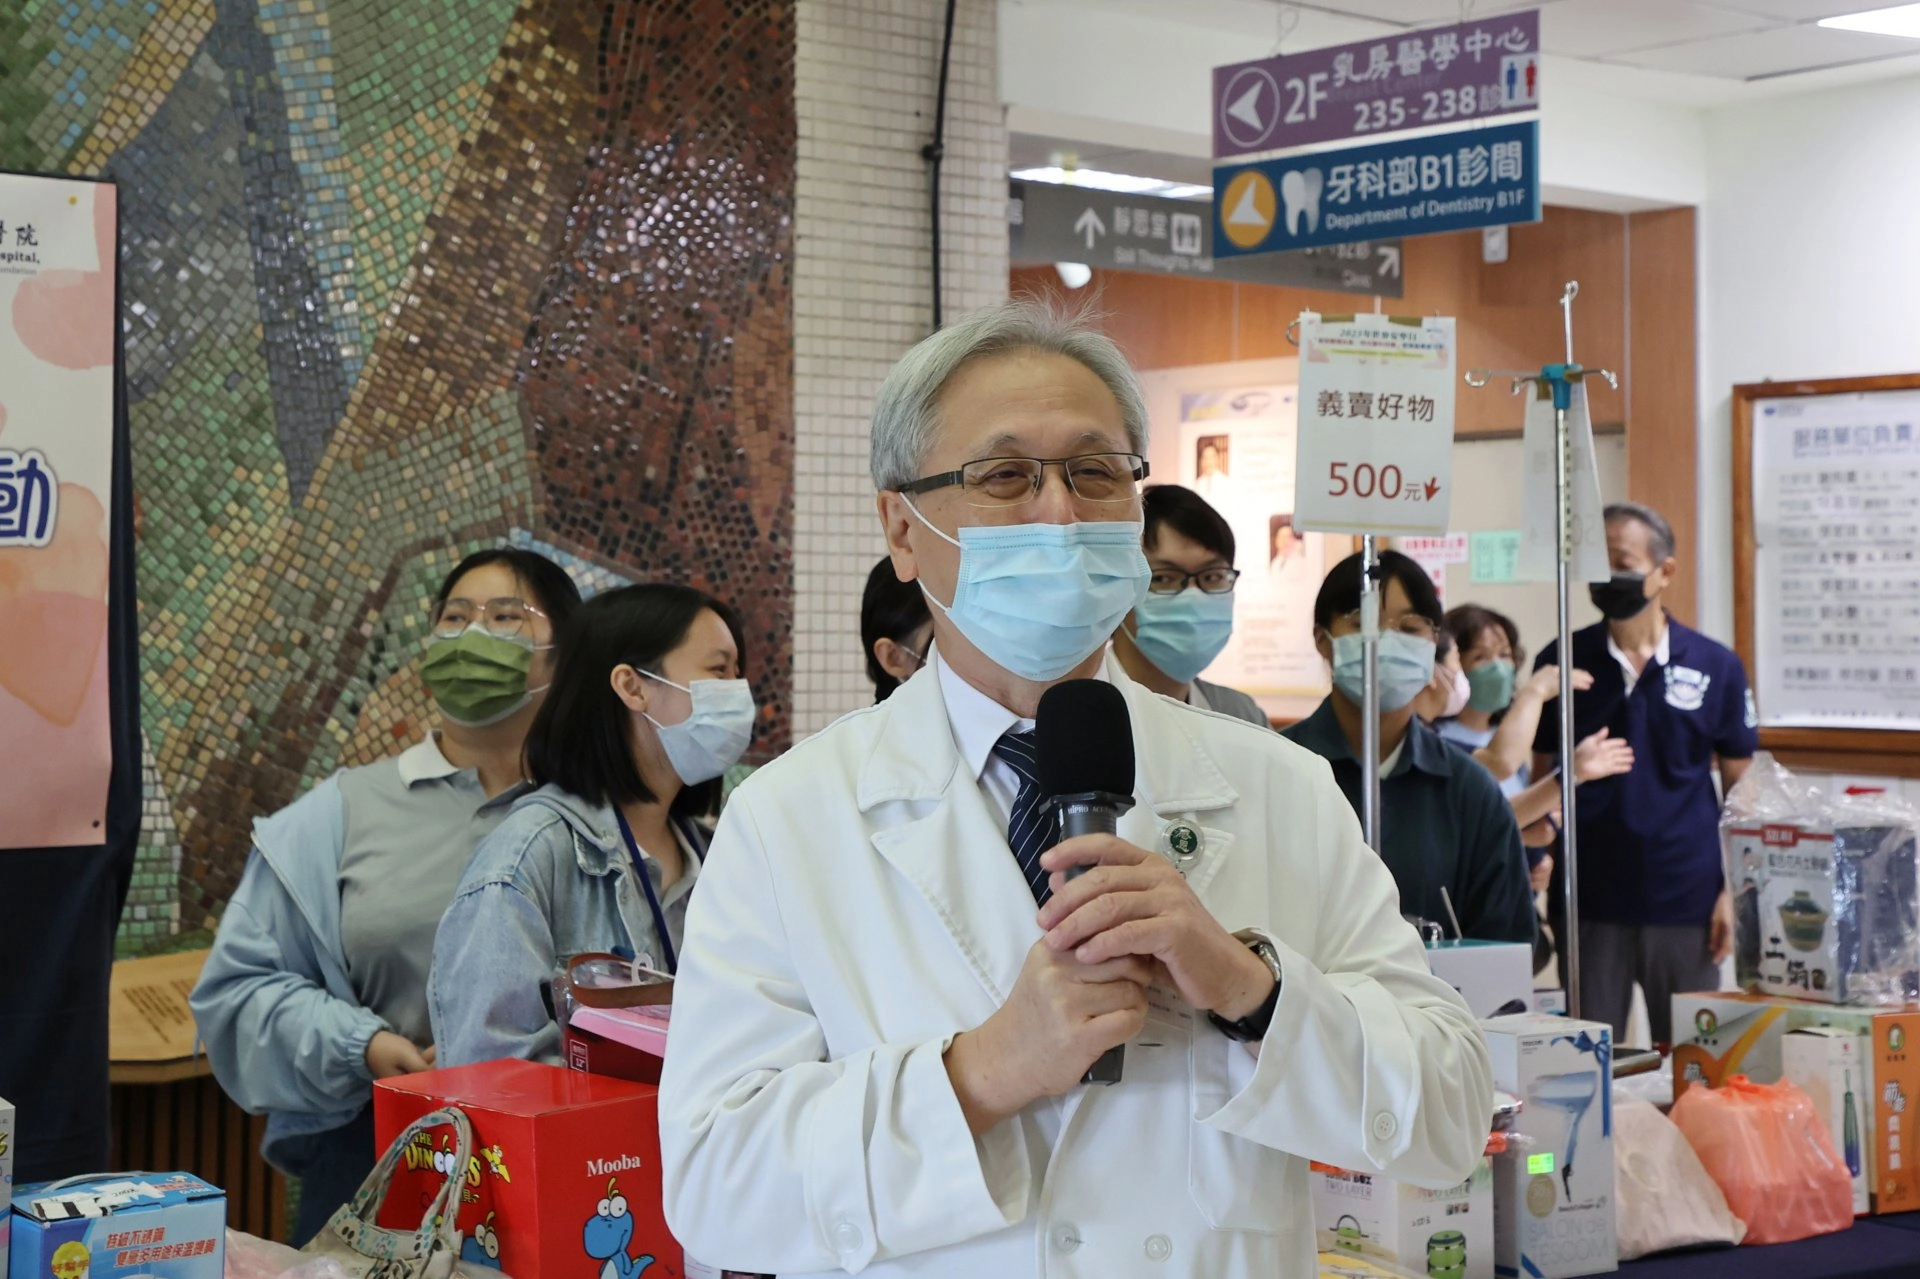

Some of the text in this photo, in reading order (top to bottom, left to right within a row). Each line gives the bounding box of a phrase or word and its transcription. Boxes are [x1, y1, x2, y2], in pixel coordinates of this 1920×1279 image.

[1333, 26, 1530, 88] 乳房醫學中心
[1284, 72, 1328, 124] 2F
[1326, 140, 1522, 204] 牙科部B1診間
[1325, 188, 1525, 230] Department of Dentistry B1F
[1317, 389, 1435, 422] 義賣好物
[586, 1153, 641, 1178] Mooba
